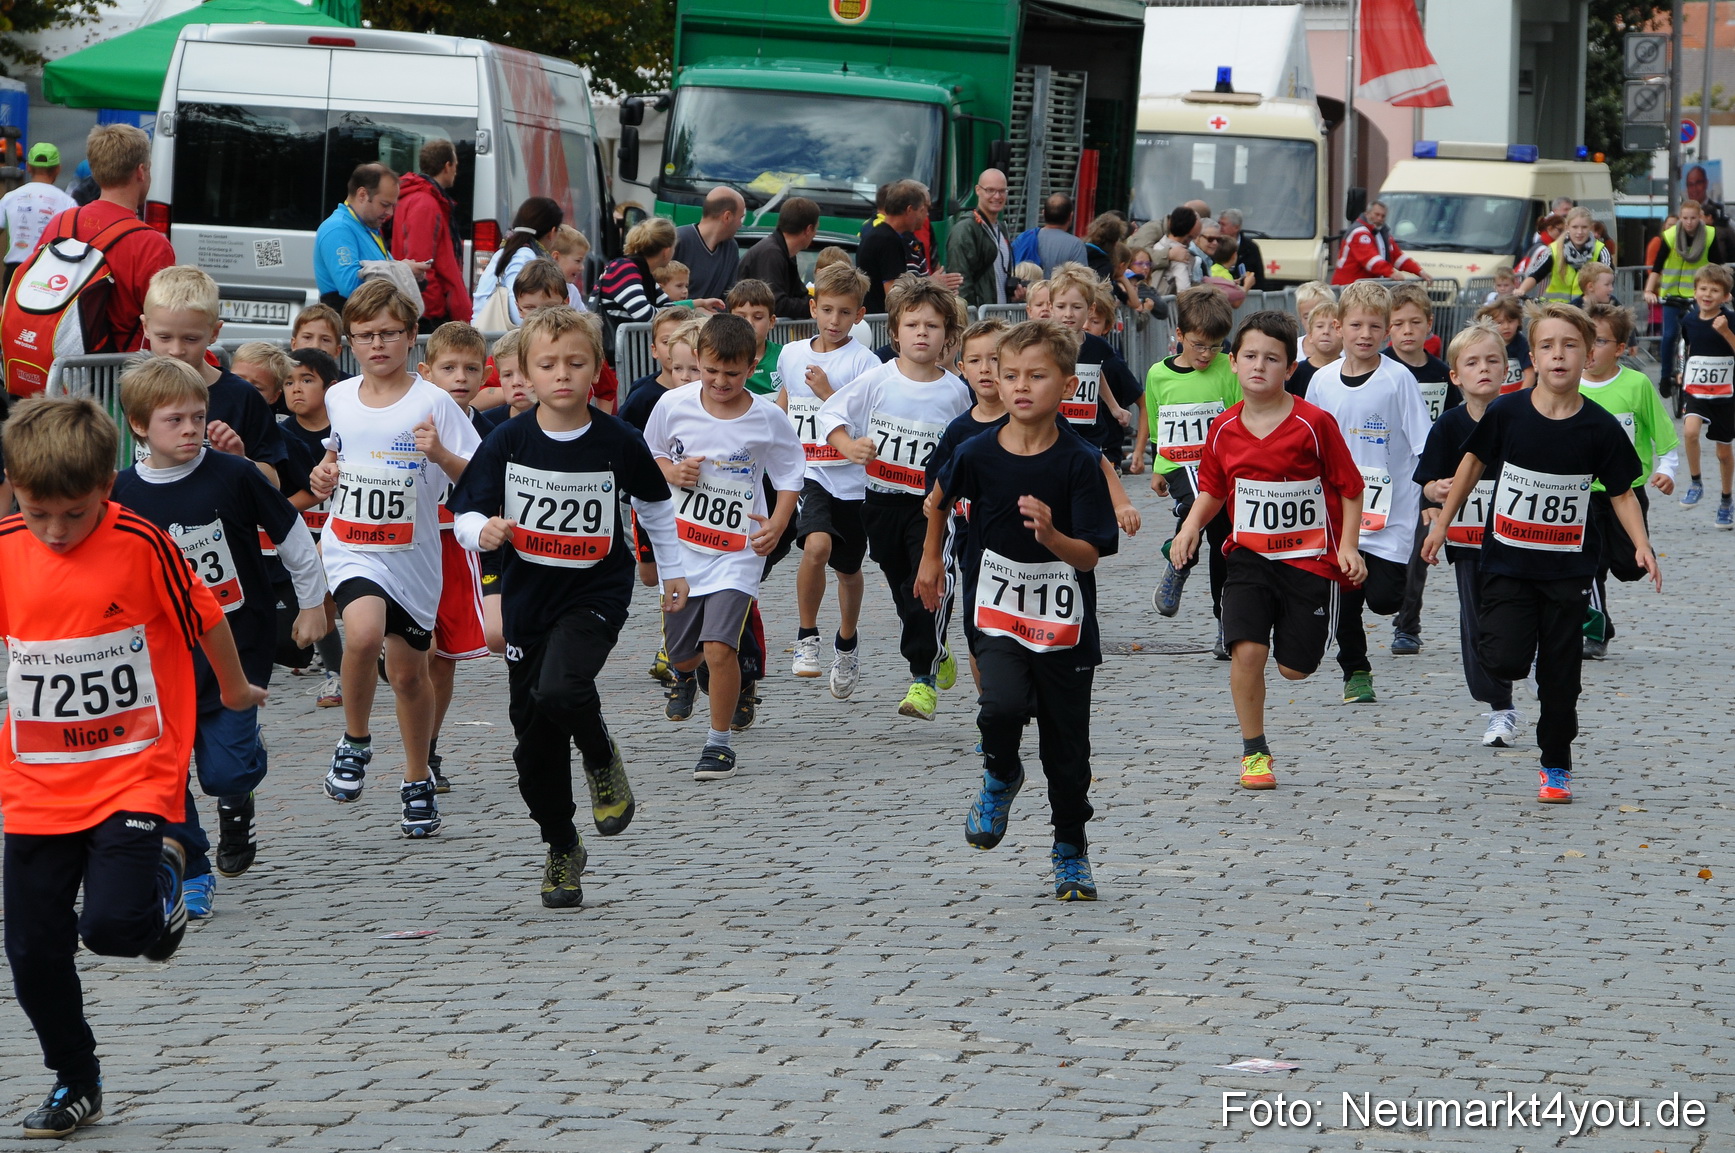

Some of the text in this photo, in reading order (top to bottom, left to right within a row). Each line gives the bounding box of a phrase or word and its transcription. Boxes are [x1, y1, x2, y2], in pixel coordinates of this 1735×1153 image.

[253, 303, 287, 320] 1111
[1506, 369, 1523, 384] 29
[1691, 368, 1728, 384] 7367
[1076, 381, 1096, 402] 40
[789, 404, 808, 412] PARTL
[1062, 406, 1084, 416] Leon
[1181, 409, 1214, 417] Neumarkt
[794, 415, 817, 440] 71
[871, 418, 935, 438] PARTL Neumarkt
[805, 447, 839, 458] Moritz
[877, 430, 937, 467] 7112
[356, 475, 401, 487] Neumarkt
[509, 473, 598, 492] PARTL Neumarkt
[879, 465, 923, 486] Dominik
[1503, 471, 1577, 491] PARTL Neumarkt
[702, 482, 742, 498] Neumarkt
[1238, 486, 1311, 498] PARTL Neumarkt
[340, 484, 405, 521] 7105
[517, 491, 603, 534] 7229
[679, 487, 744, 529] 7086
[1507, 486, 1579, 524] 7185
[1246, 499, 1316, 530] 7096
[346, 526, 385, 541] Jonas
[686, 526, 720, 546] David
[1501, 521, 1573, 542] Maximilian
[182, 538, 210, 553] markt
[525, 535, 587, 556] Michael
[1268, 536, 1294, 550] Luis
[984, 559, 1069, 581] PARTL Neumarkt
[992, 575, 1074, 619] 7119
[1012, 621, 1045, 640] Jona
[12, 645, 125, 666] PARTL Neumarkt
[20, 663, 138, 718] 7259
[63, 727, 109, 747] Nico
[125, 818, 151, 831] JAKO
